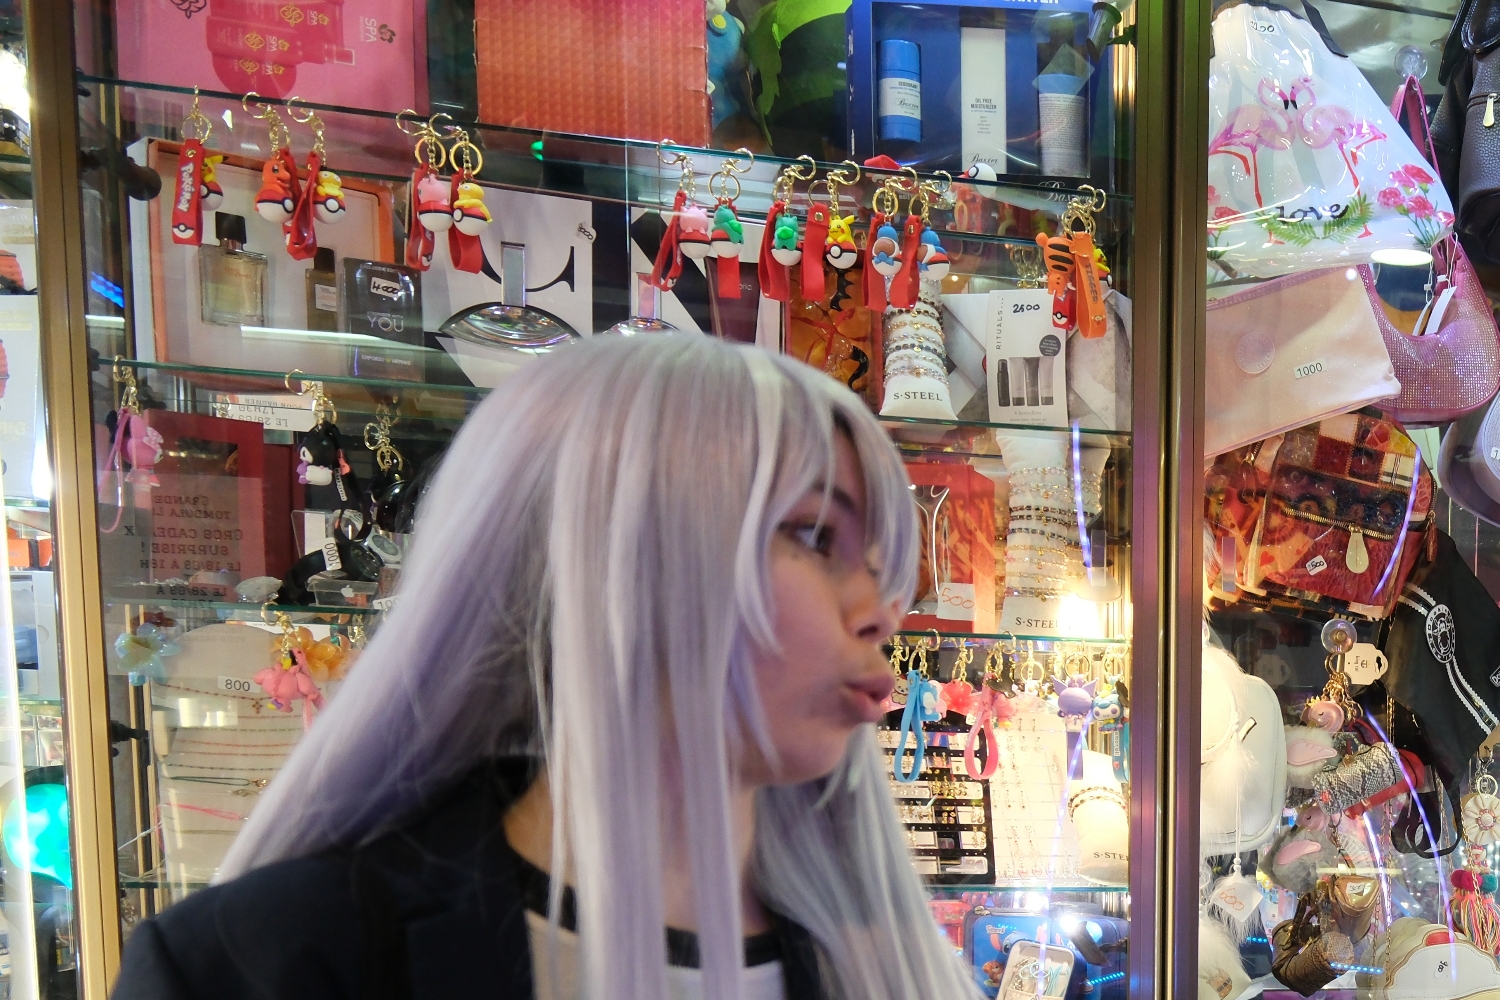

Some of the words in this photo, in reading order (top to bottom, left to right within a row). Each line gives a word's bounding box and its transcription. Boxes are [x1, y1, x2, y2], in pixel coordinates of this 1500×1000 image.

[364, 17, 377, 43] SPA
[966, 153, 999, 166] Baxter
[1084, 262, 1099, 304] TIGGER
[367, 315, 404, 333] YOU
[1296, 362, 1324, 378] 1000
[324, 541, 340, 568] 1000
[941, 587, 975, 609] 500
[1015, 616, 1059, 629] S·STEE
[225, 679, 251, 692] 800
[1218, 887, 1245, 911] 600
